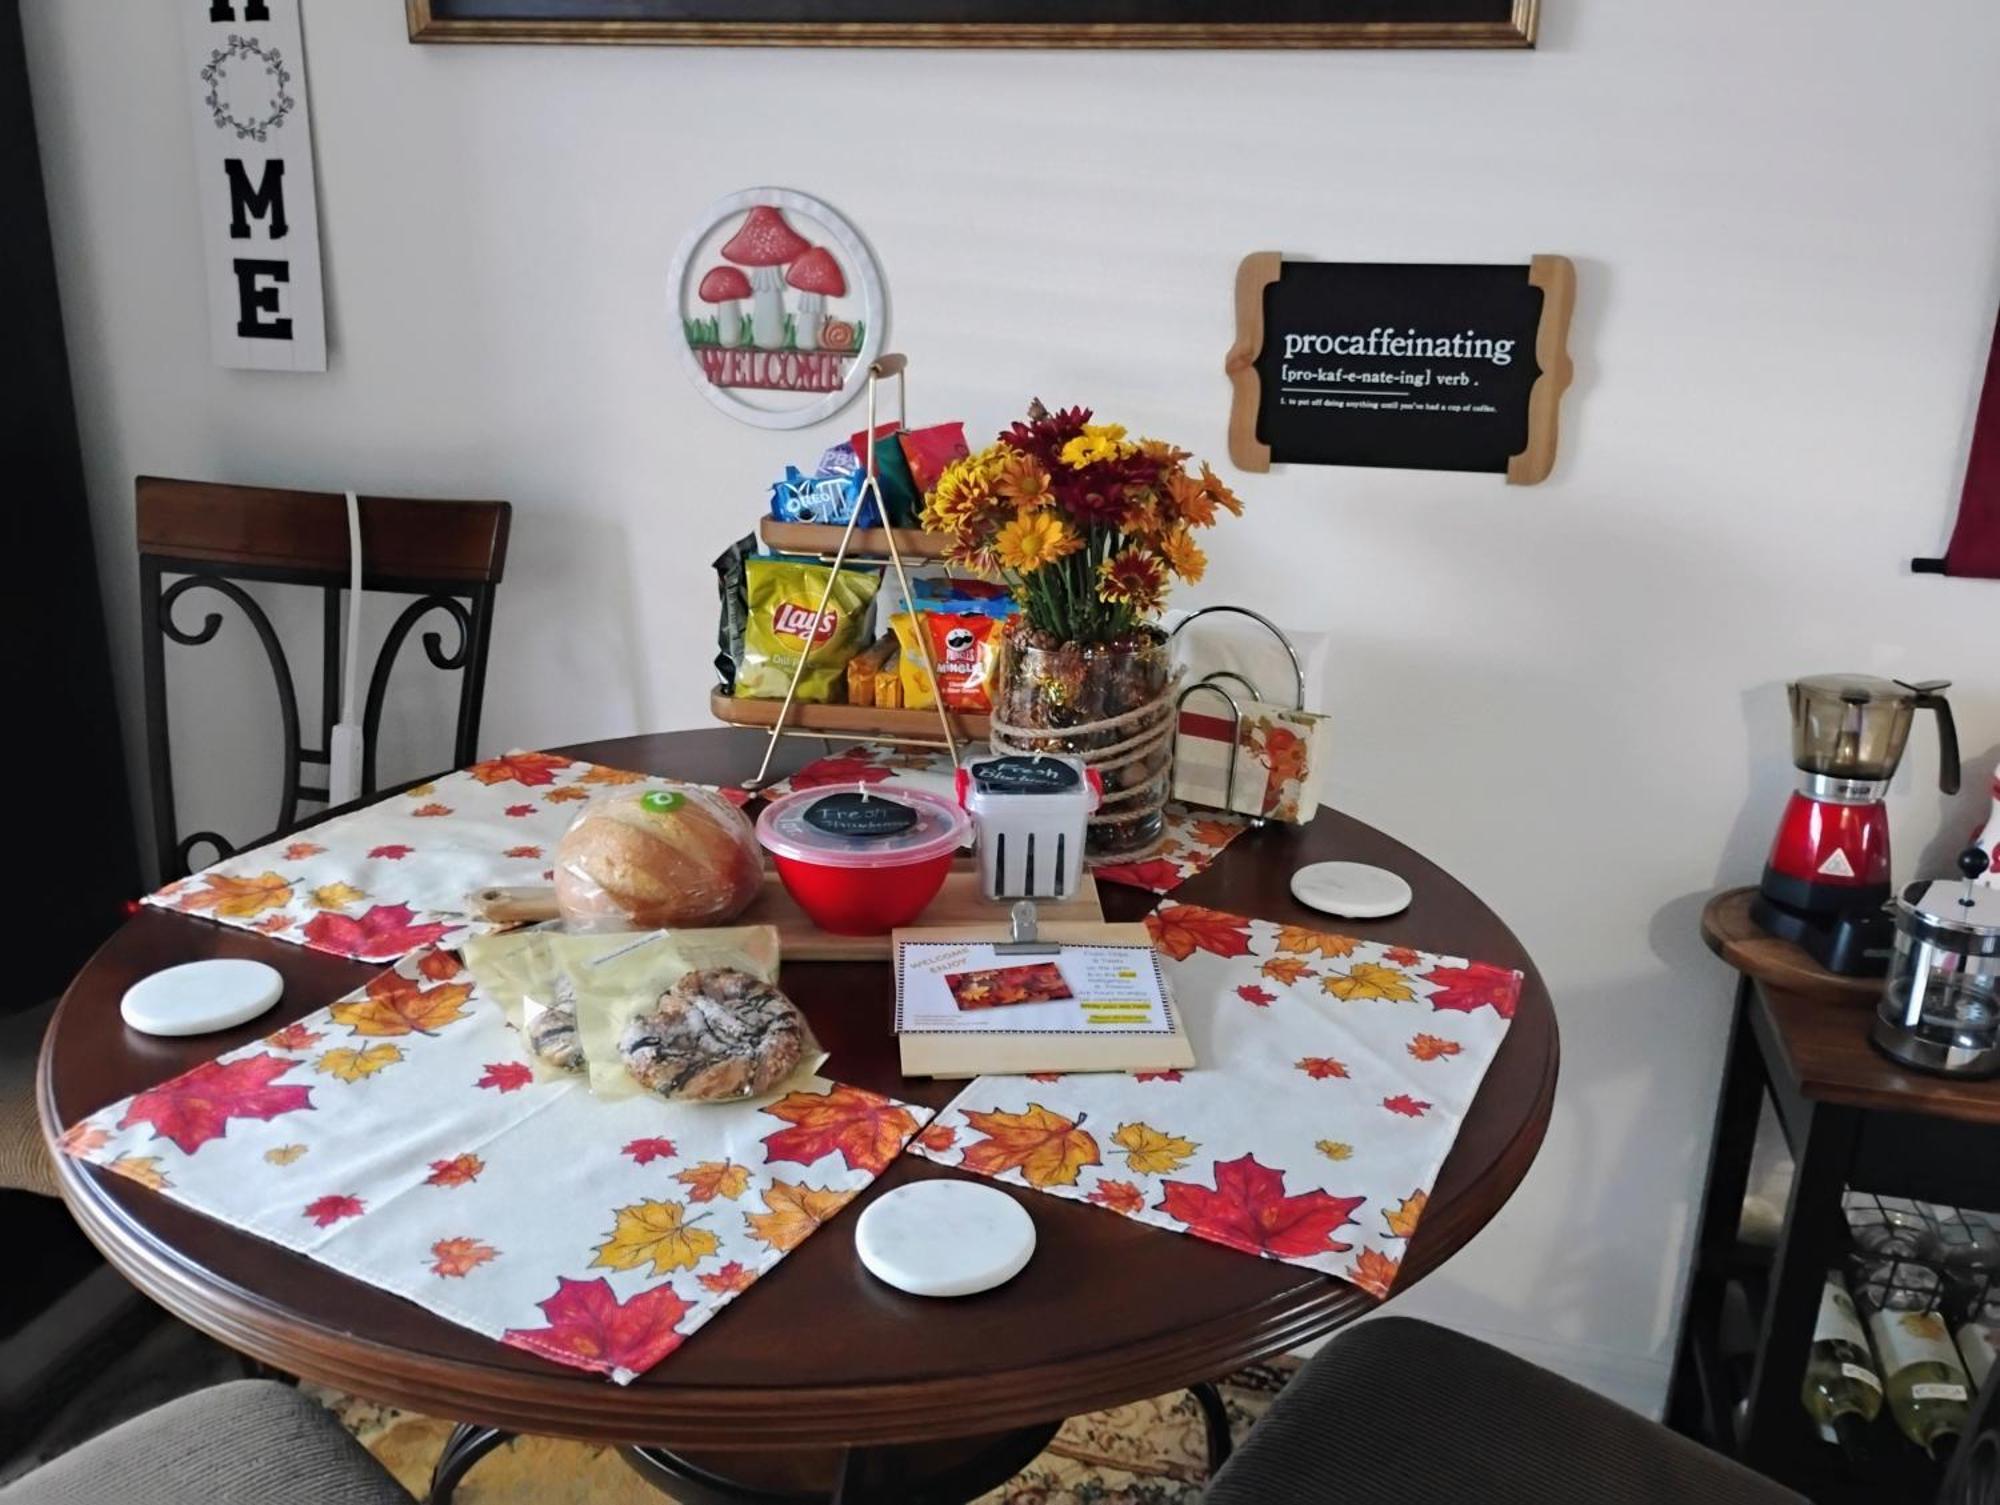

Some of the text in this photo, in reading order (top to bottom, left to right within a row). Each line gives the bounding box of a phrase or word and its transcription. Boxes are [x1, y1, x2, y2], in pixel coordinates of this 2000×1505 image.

[1284, 327, 1515, 364] procaffeinating
[702, 350, 844, 392] WELCOME
[1281, 364, 1431, 386] [pro-kaf-e-nate-ing]
[1436, 371, 1469, 386] verb
